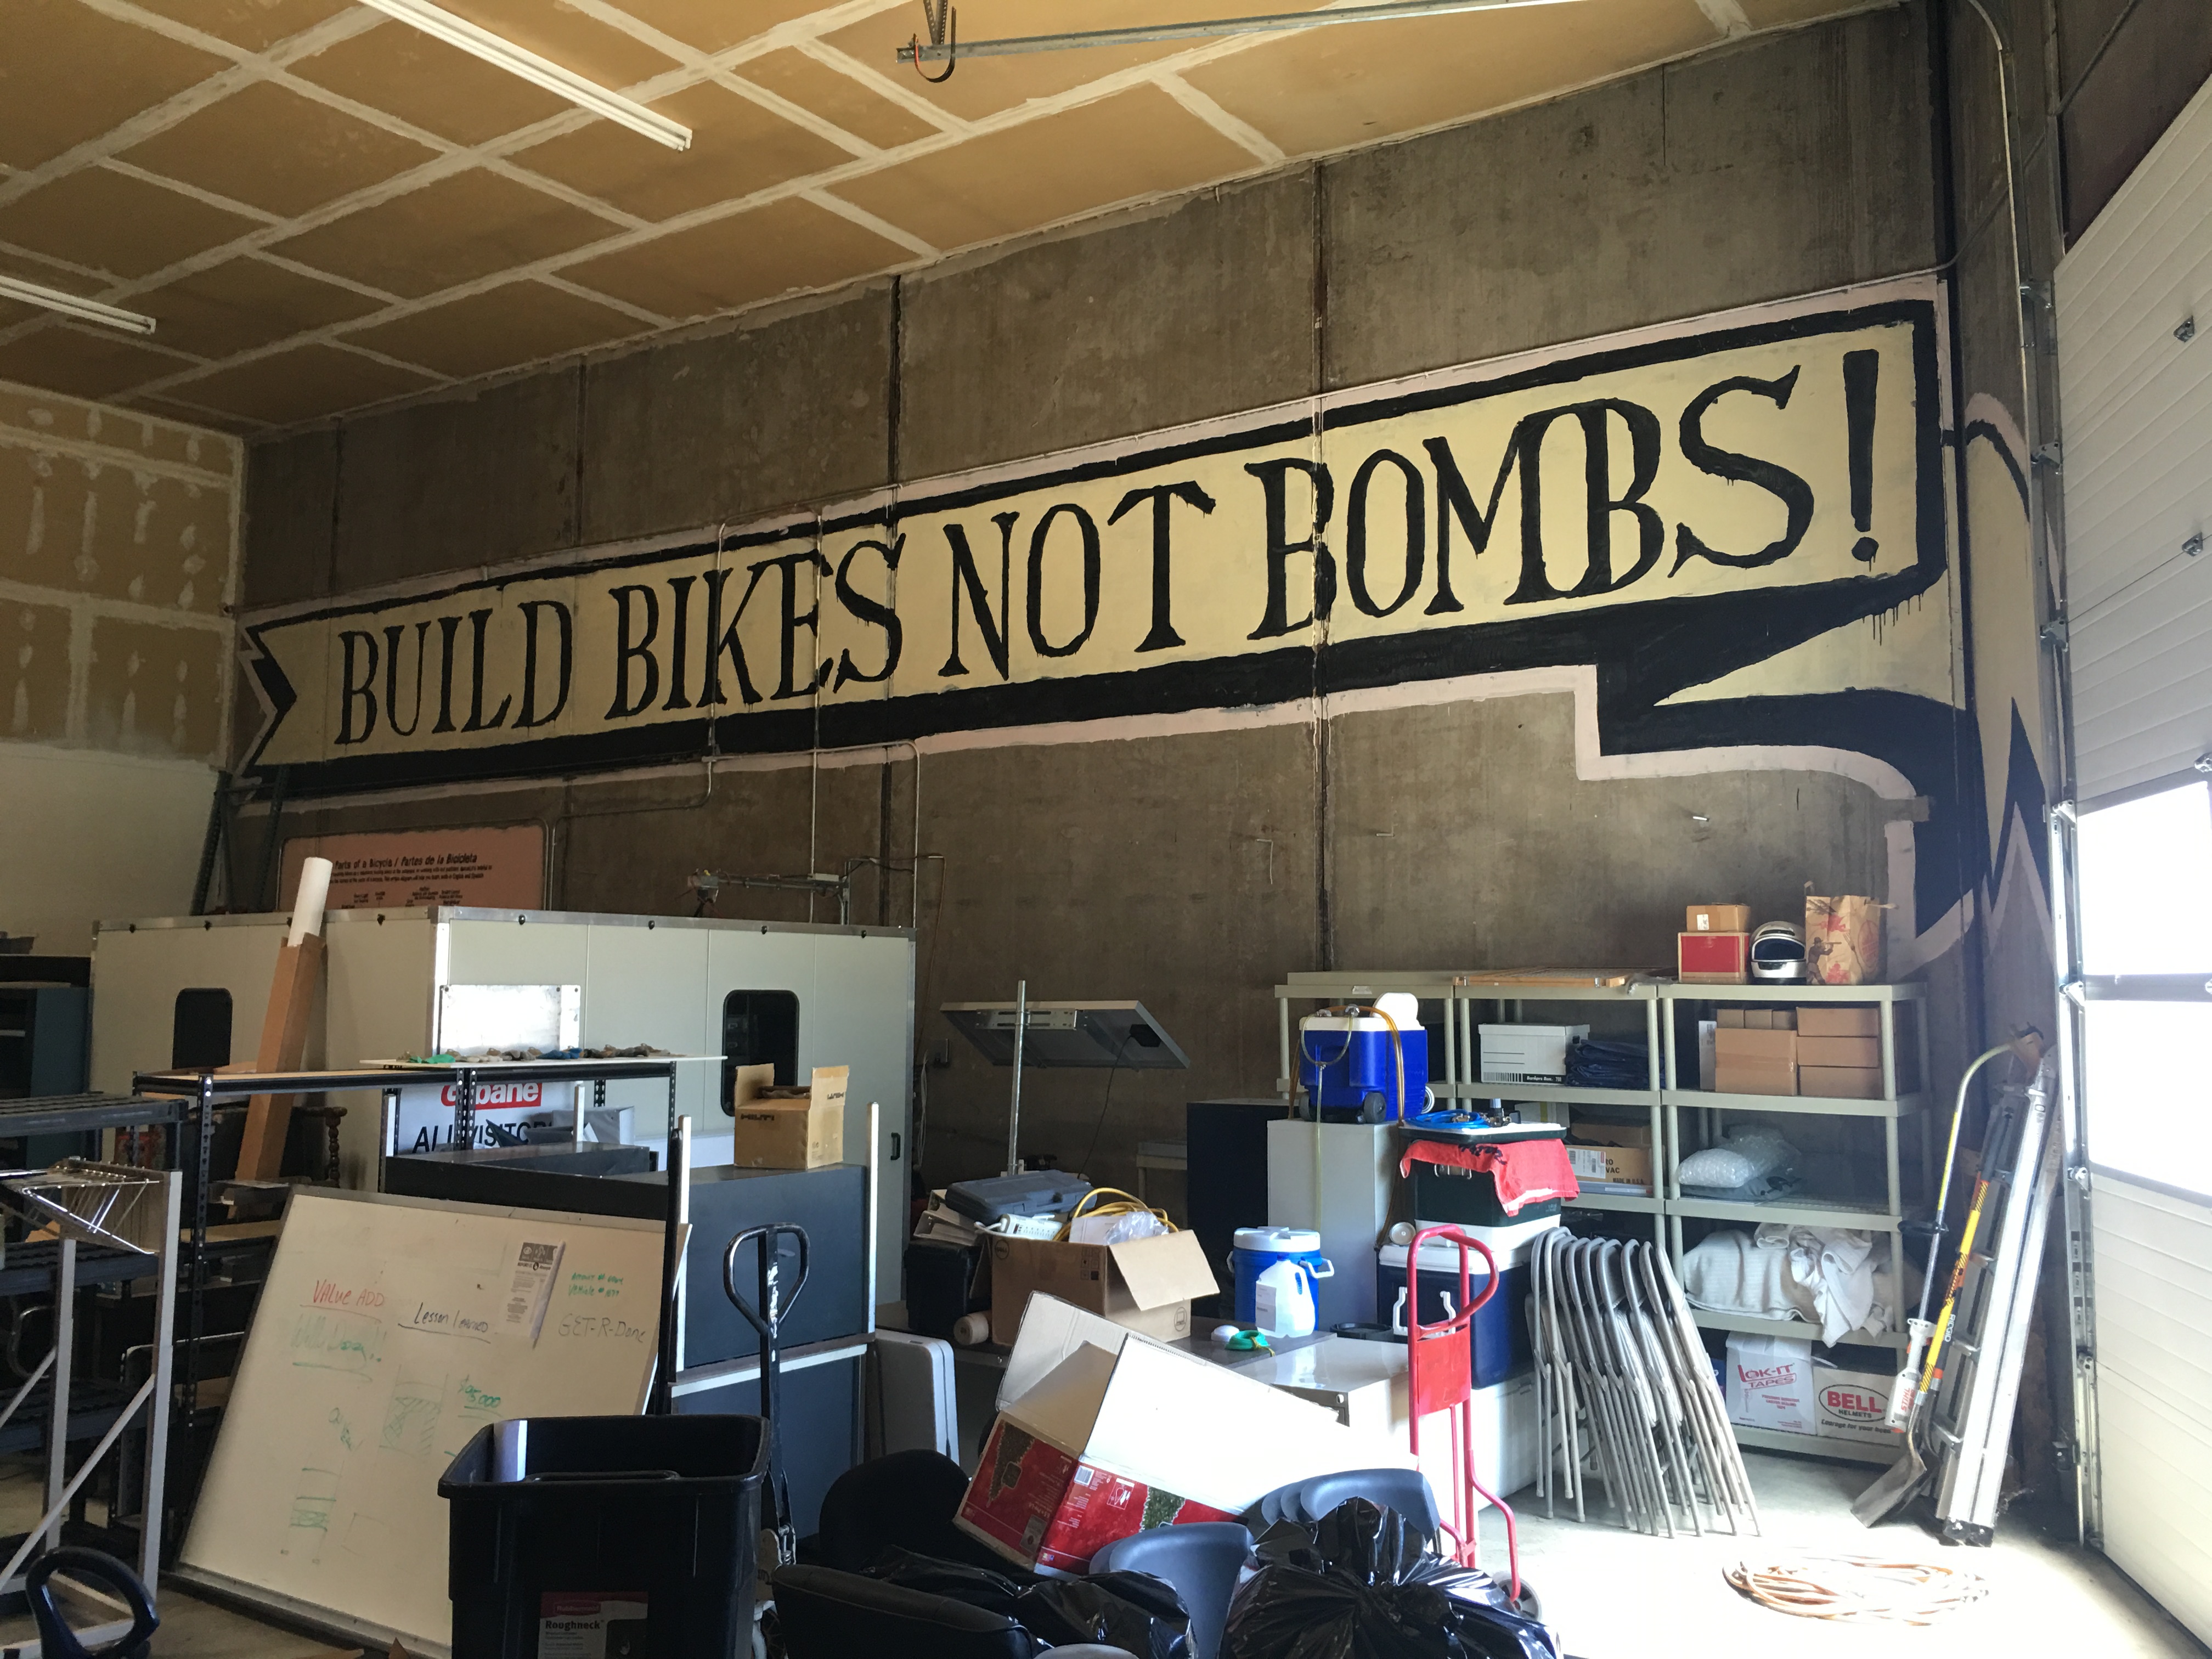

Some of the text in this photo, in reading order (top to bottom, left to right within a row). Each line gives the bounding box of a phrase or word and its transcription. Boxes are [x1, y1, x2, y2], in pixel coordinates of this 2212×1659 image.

[335, 349, 1879, 745] BUILD BIKES NOT BOMBS!
[353, 859, 360, 868] of
[369, 858, 393, 868] Bicycle
[401, 856, 422, 867] Partes
[425, 855, 435, 865] de
[437, 854, 444, 865] la
[446, 853, 478, 865] Bicicleta
[356, 1288, 385, 1307] ADD
[414, 1302, 449, 1324] Lesson
[1748, 1376, 1795, 1388] TAPES
[1827, 1391, 1882, 1413] BELL
[1901, 1387, 1911, 1412] STIHL
[1839, 1409, 1872, 1419] HELMETS
[545, 1620, 601, 1632] Roughneck
